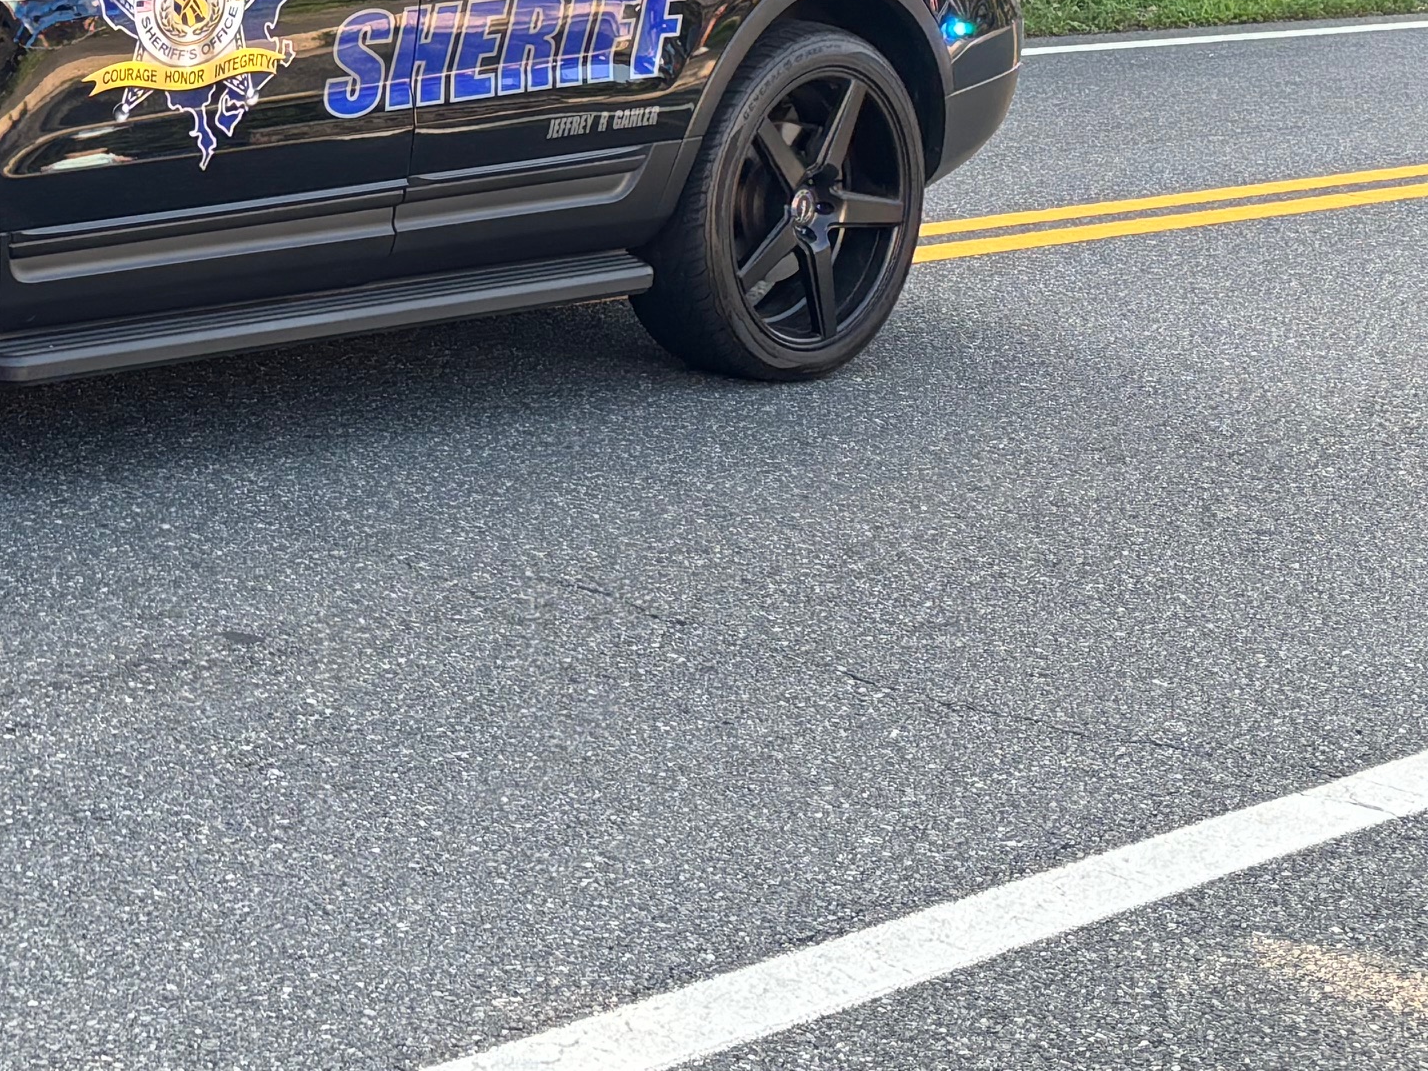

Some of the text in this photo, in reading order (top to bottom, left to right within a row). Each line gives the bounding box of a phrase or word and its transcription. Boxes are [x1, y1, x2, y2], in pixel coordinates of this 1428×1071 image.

[140, 5, 239, 61] SHERIFF'S OFFICE
[102, 52, 273, 86] COURAGE HONOR INTEGRITY
[546, 105, 661, 140] JEFFREY R GAHLER
